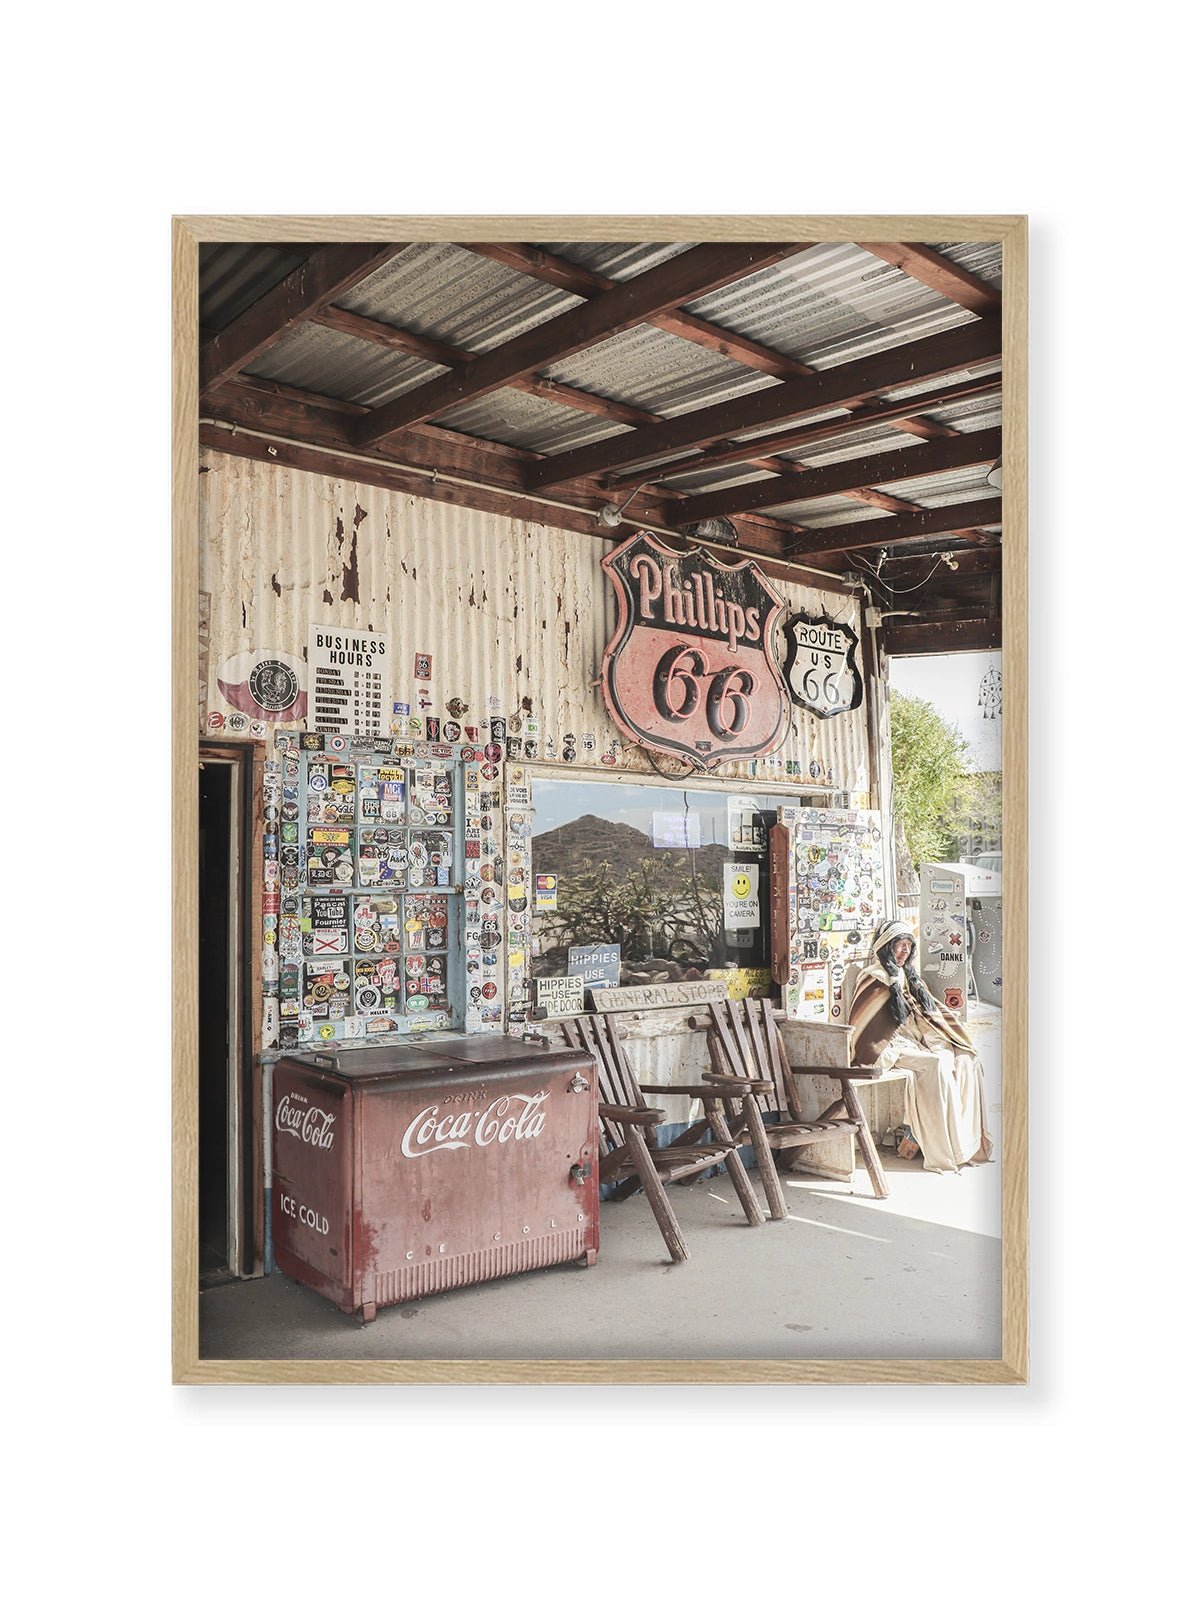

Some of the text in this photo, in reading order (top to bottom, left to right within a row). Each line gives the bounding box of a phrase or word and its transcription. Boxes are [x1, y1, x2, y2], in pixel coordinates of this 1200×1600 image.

[630, 553, 761, 653] Phillips
[316, 634, 386, 655] BUSINESS
[799, 627, 842, 650] ROUTE
[330, 650, 373, 667] HOURS
[652, 644, 761, 742] 66
[802, 668, 840, 705] 66
[731, 865, 752, 873] SMILE!
[932, 882, 952, 890] Phone
[749, 900, 758, 908] ON
[729, 910, 756, 918] CAMERA
[571, 952, 618, 966] HIPPIES
[940, 952, 964, 962] DANKE
[584, 969, 605, 980] USE
[539, 977, 582, 991] HIPPIES
[551, 990, 571, 1000] USE
[600, 987, 675, 1009] GENERAL
[677, 983, 727, 1004] STORE
[560, 998, 583, 1012] DOOR
[290, 1092, 308, 1104] DRINK
[443, 1090, 489, 1104] DRINK
[401, 1089, 552, 1159] Coca-Cola
[280, 1193, 329, 1236] ICE COLD
